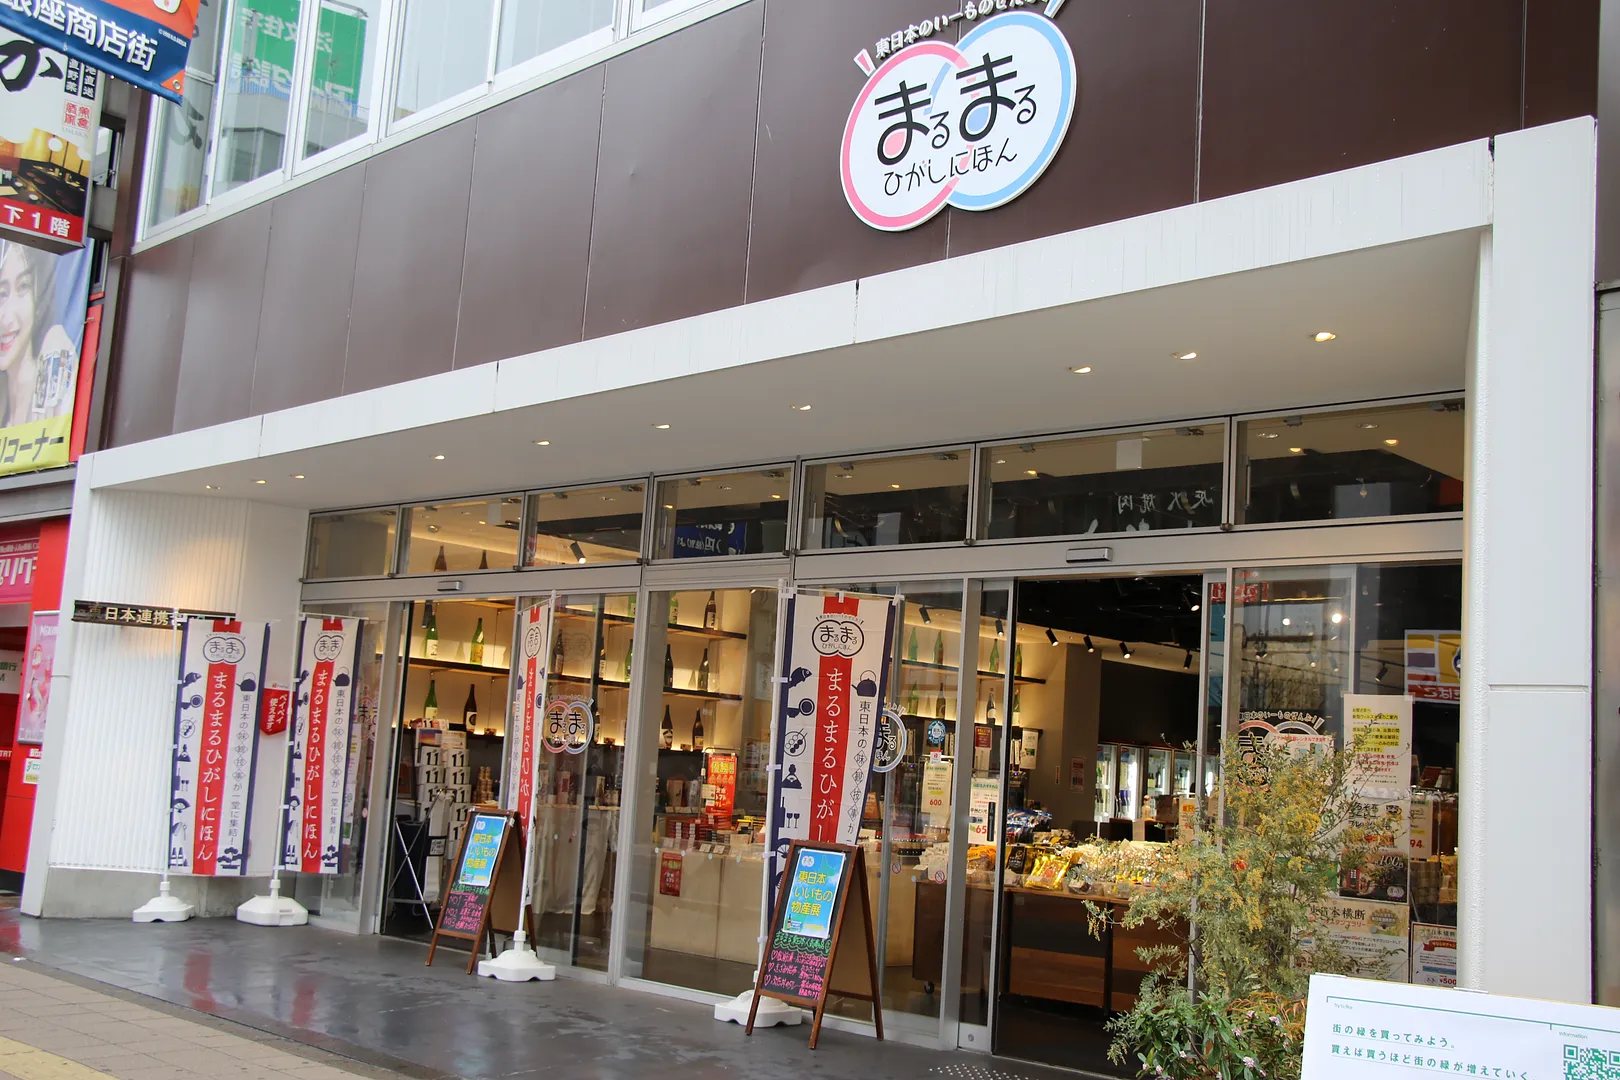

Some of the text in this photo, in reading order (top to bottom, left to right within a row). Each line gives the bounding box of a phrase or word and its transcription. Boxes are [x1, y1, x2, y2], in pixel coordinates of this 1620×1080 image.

[874, 53, 1038, 165] まるまる
[884, 138, 1018, 196] ひがしにほん
[197, 671, 228, 861] まるまるひがしにほん
[303, 669, 329, 859] まるまるひがしにほん
[794, 885, 833, 902] いいもの
[798, 870, 827, 885] 東日本
[791, 901, 821, 917] 物産展
[1332, 1023, 1455, 1050] 街の緑を買ってみよう。
[1331, 1044, 1537, 1080] 買えば買うほど街の緑が増えていく
